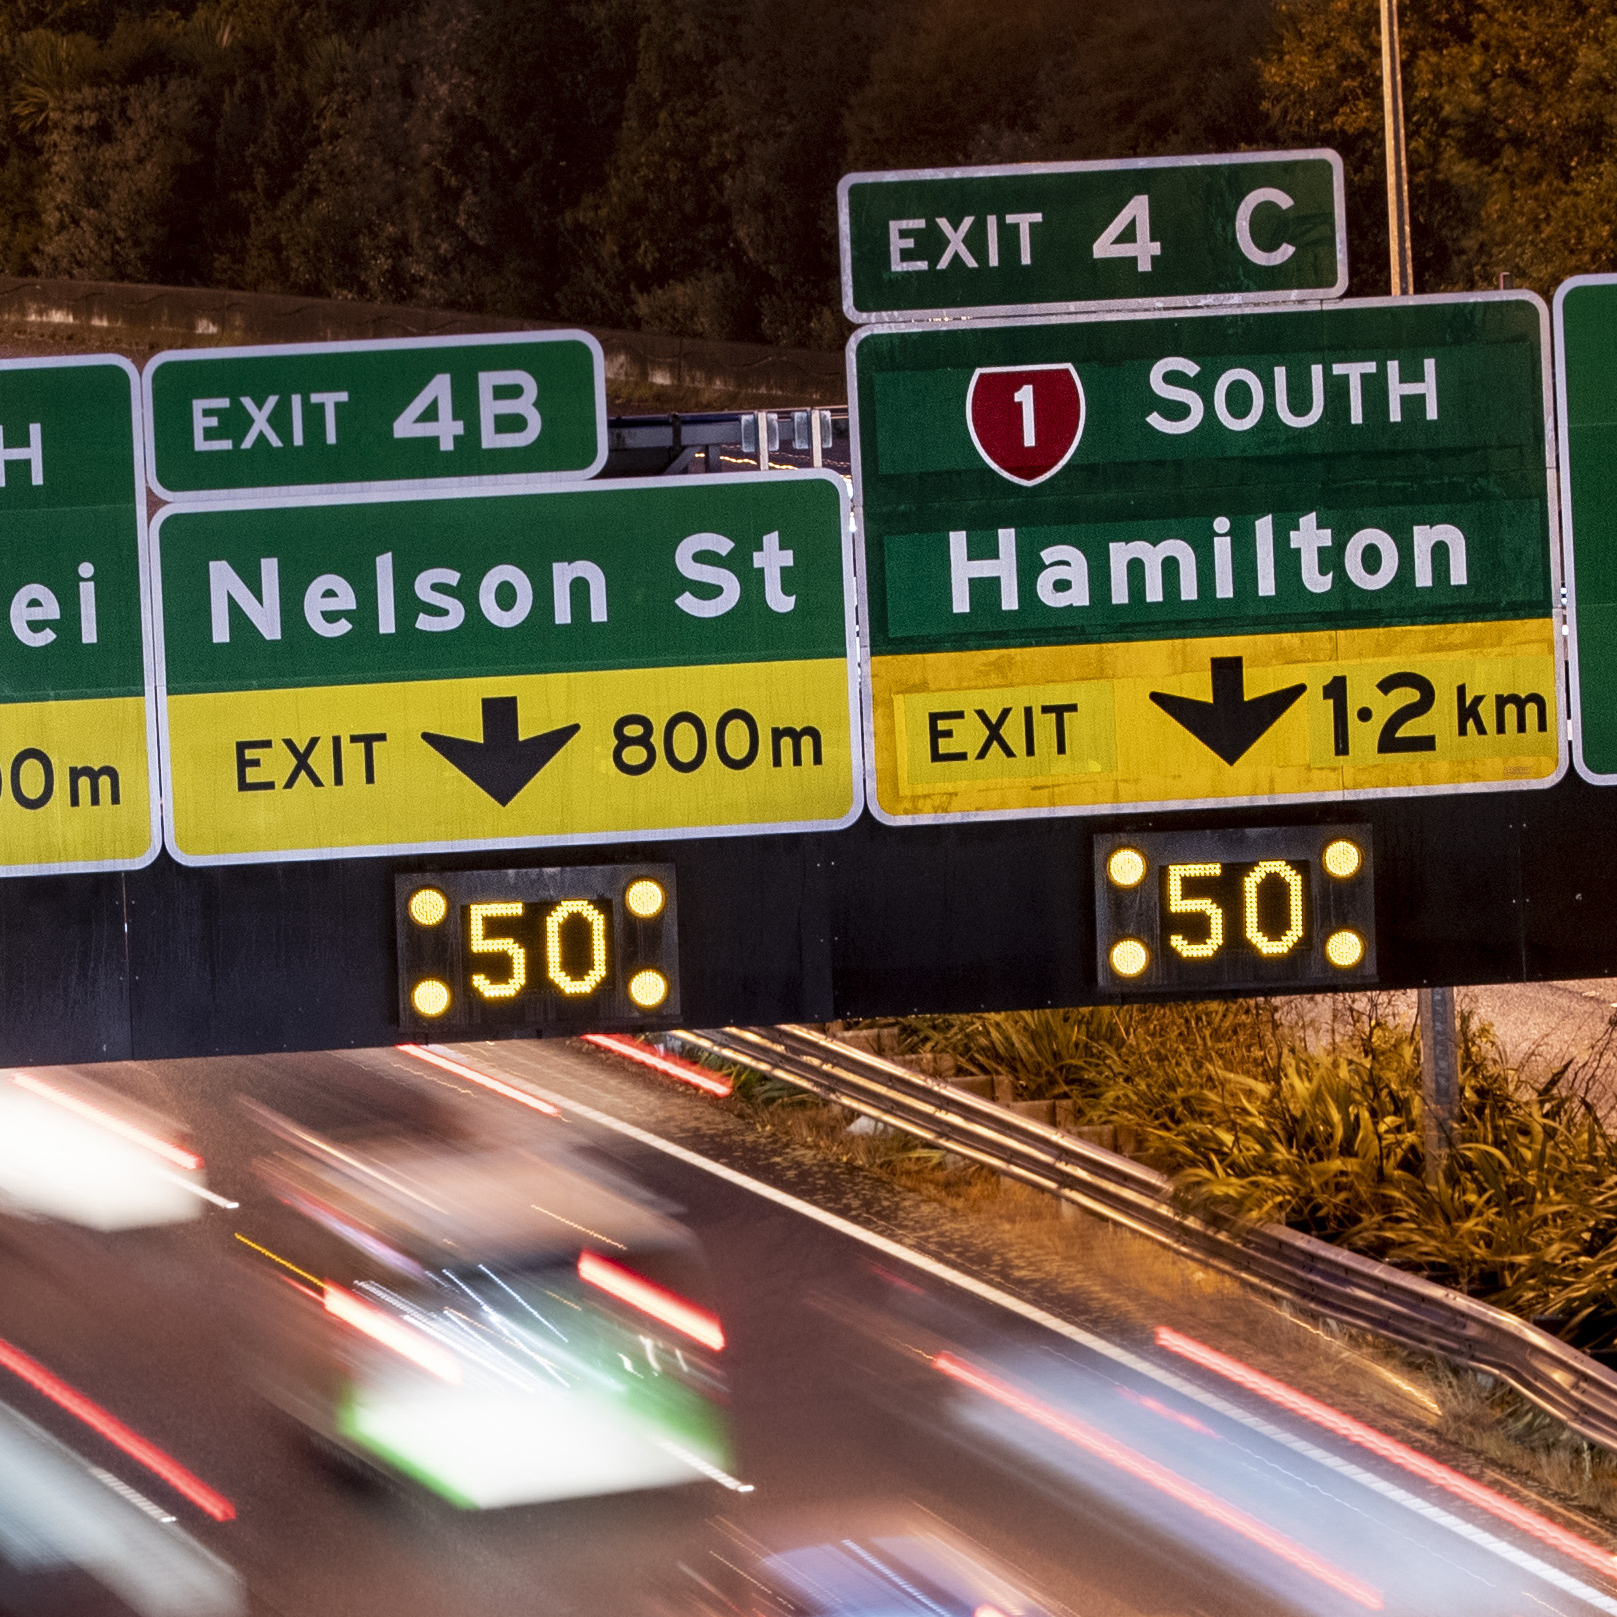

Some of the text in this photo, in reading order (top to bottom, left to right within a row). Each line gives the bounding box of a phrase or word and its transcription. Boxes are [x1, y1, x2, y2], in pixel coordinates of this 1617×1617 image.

[888, 211, 1044, 272] EXIT
[191, 369, 542, 452] EXIT 4B
[1013, 384, 1036, 448] 1
[1145, 356, 1439, 435] SOUTH
[208, 530, 797, 644] Nelson St
[948, 511, 1468, 614] Hamilton
[235, 732, 388, 792] EXIT
[928, 703, 1079, 763] EXIT
[469, 899, 607, 999] 50
[1168, 860, 1304, 958] 50
